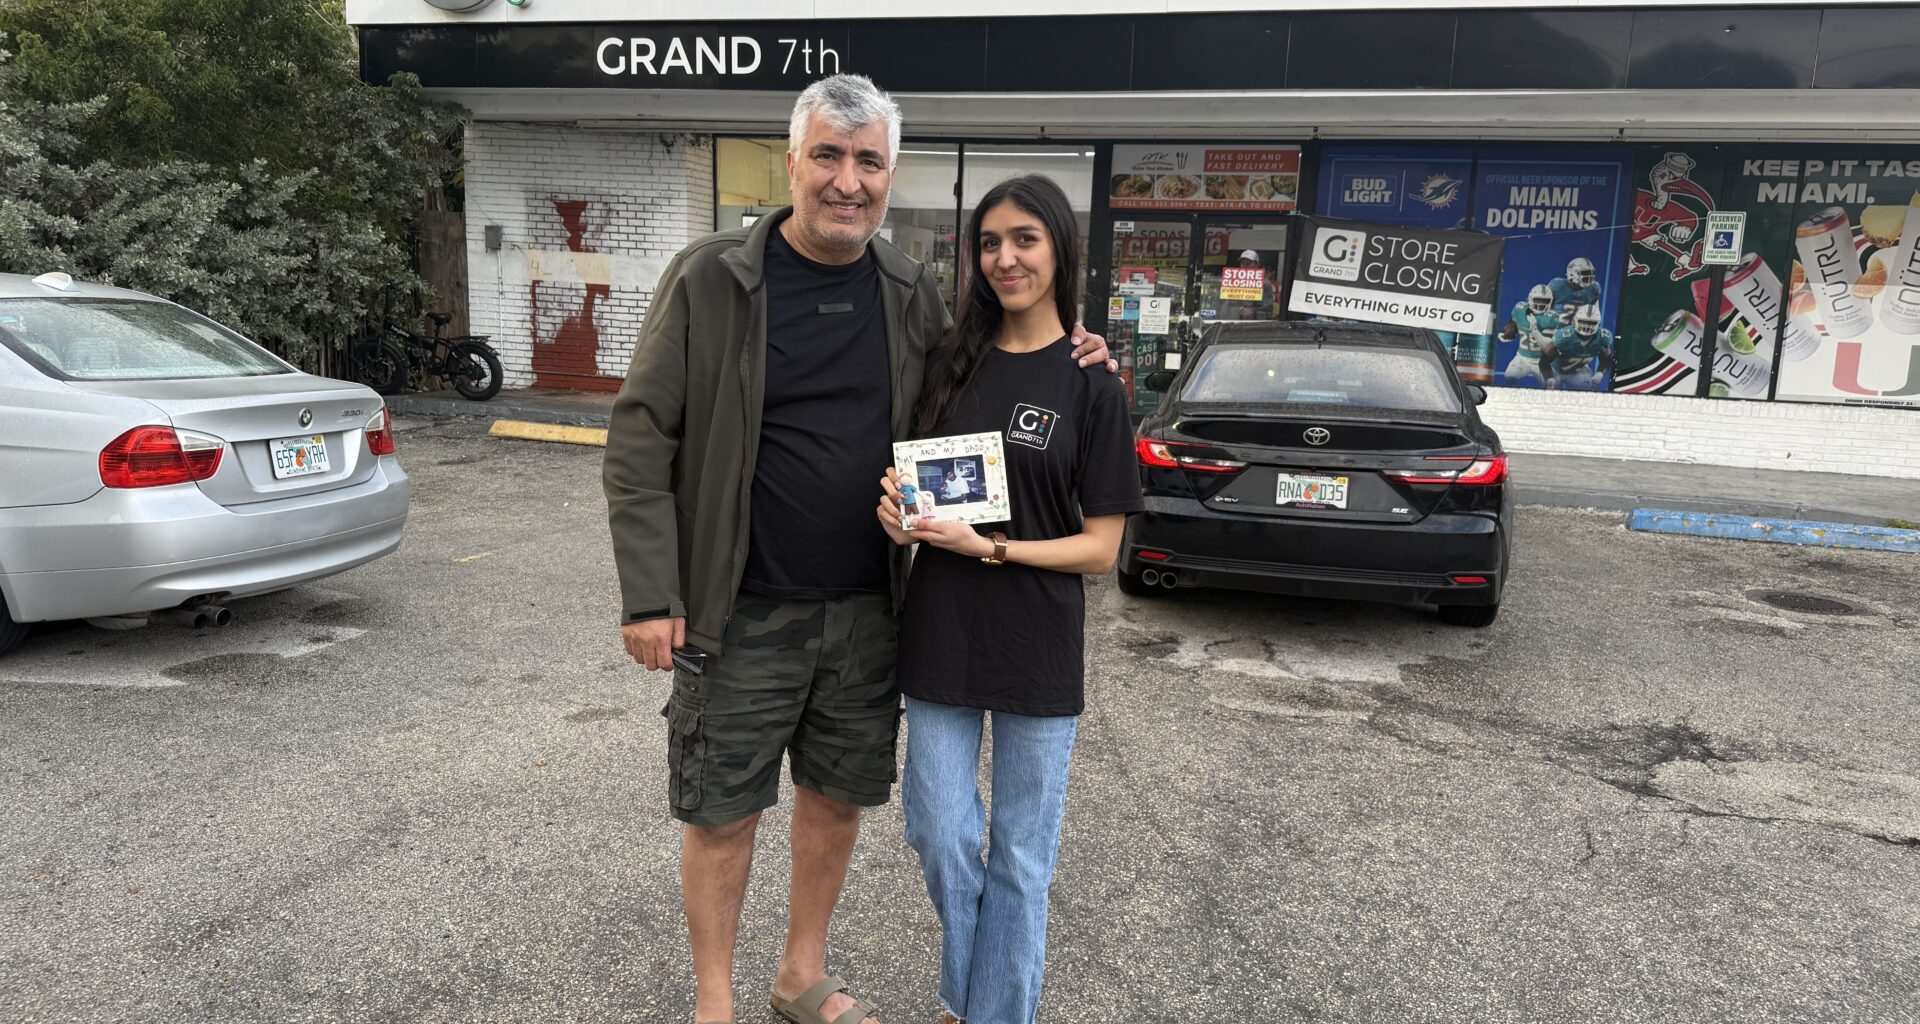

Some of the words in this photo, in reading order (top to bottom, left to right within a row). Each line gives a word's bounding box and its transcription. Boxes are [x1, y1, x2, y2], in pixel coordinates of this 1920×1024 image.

[596, 36, 762, 75] GRAND
[778, 38, 840, 75] 7th
[1208, 153, 1233, 161] TAKE
[1237, 153, 1257, 161] OUT
[1261, 153, 1282, 161] AND
[1207, 162, 1231, 170] FAST
[1234, 162, 1285, 170] DELIVERY
[1743, 159, 1825, 177] KEEP
[1831, 159, 1859, 177] IT
[1351, 178, 1387, 191] BUD
[1486, 174, 1520, 184] OFFICIAL
[1521, 175, 1541, 185] BEER
[1542, 176, 1579, 185] SPONSOR
[1580, 176, 1592, 185] OF
[1592, 176, 1608, 186] THE
[1344, 190, 1392, 203] LIGHT
[1509, 186, 1580, 207] MIAMI
[1757, 182, 1876, 204] MIAMI.
[1486, 208, 1598, 231] DOLPHINS
[1710, 215, 1742, 223] RESERVED
[1368, 235, 1459, 265] STORE
[1224, 269, 1263, 280] STORE
[1313, 266, 1343, 276] GRAND
[1222, 279, 1263, 288] CLOSING
[1364, 262, 1481, 295] CLOSING
[1304, 292, 1399, 314] EVERYTHING
[1403, 304, 1448, 320] MUST
[1450, 311, 1474, 323] GO
[342, 409, 364, 417] 330i
[1011, 432, 1033, 442] GRAND
[305, 444, 327, 465] YRH
[903, 455, 914, 465] ME
[920, 448, 937, 457] AND
[943, 447, 956, 455] MY
[965, 444, 990, 455] DADDY
[1278, 481, 1302, 499] RNA
[1319, 483, 1344, 502] D35
[1295, 502, 1326, 510] AutoNation
